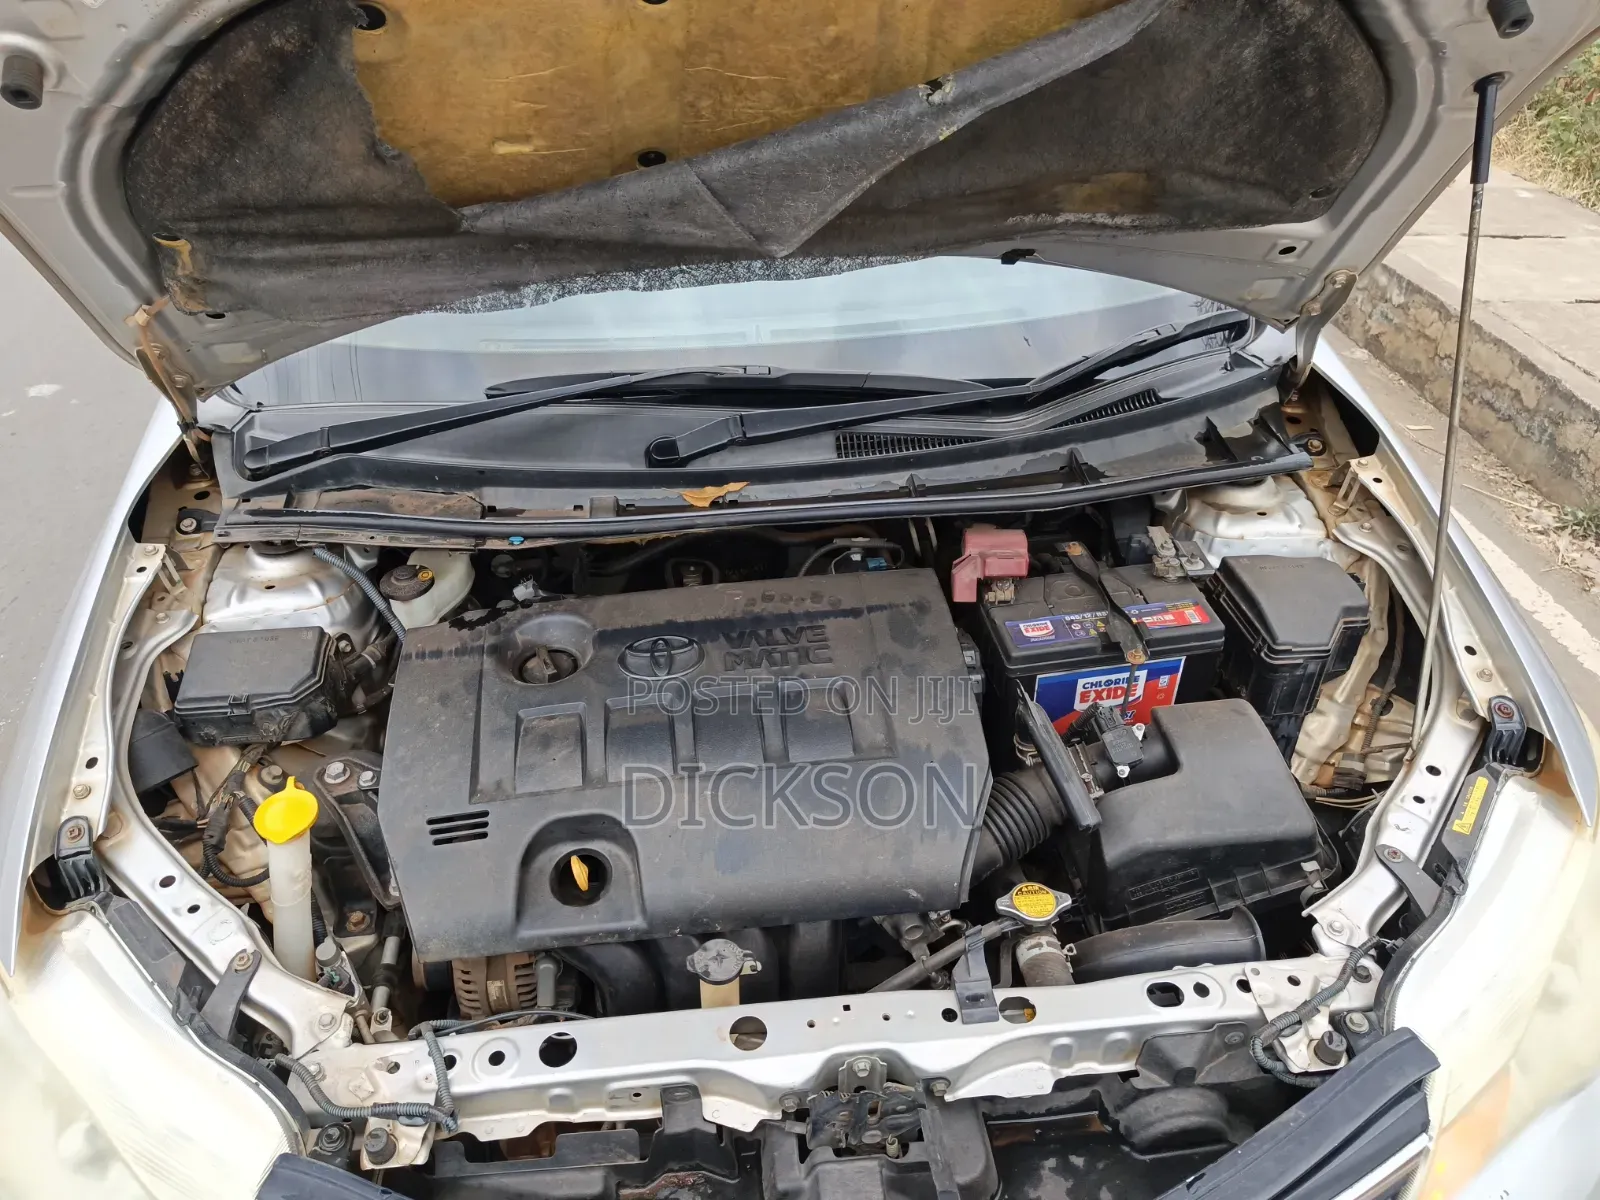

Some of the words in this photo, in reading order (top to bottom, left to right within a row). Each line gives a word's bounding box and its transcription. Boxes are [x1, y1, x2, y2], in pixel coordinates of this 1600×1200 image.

[721, 624, 830, 649] VALVE
[1023, 625, 1051, 634] EXIDE
[723, 643, 834, 672] MATIC
[1079, 683, 1139, 704] EXIDE
